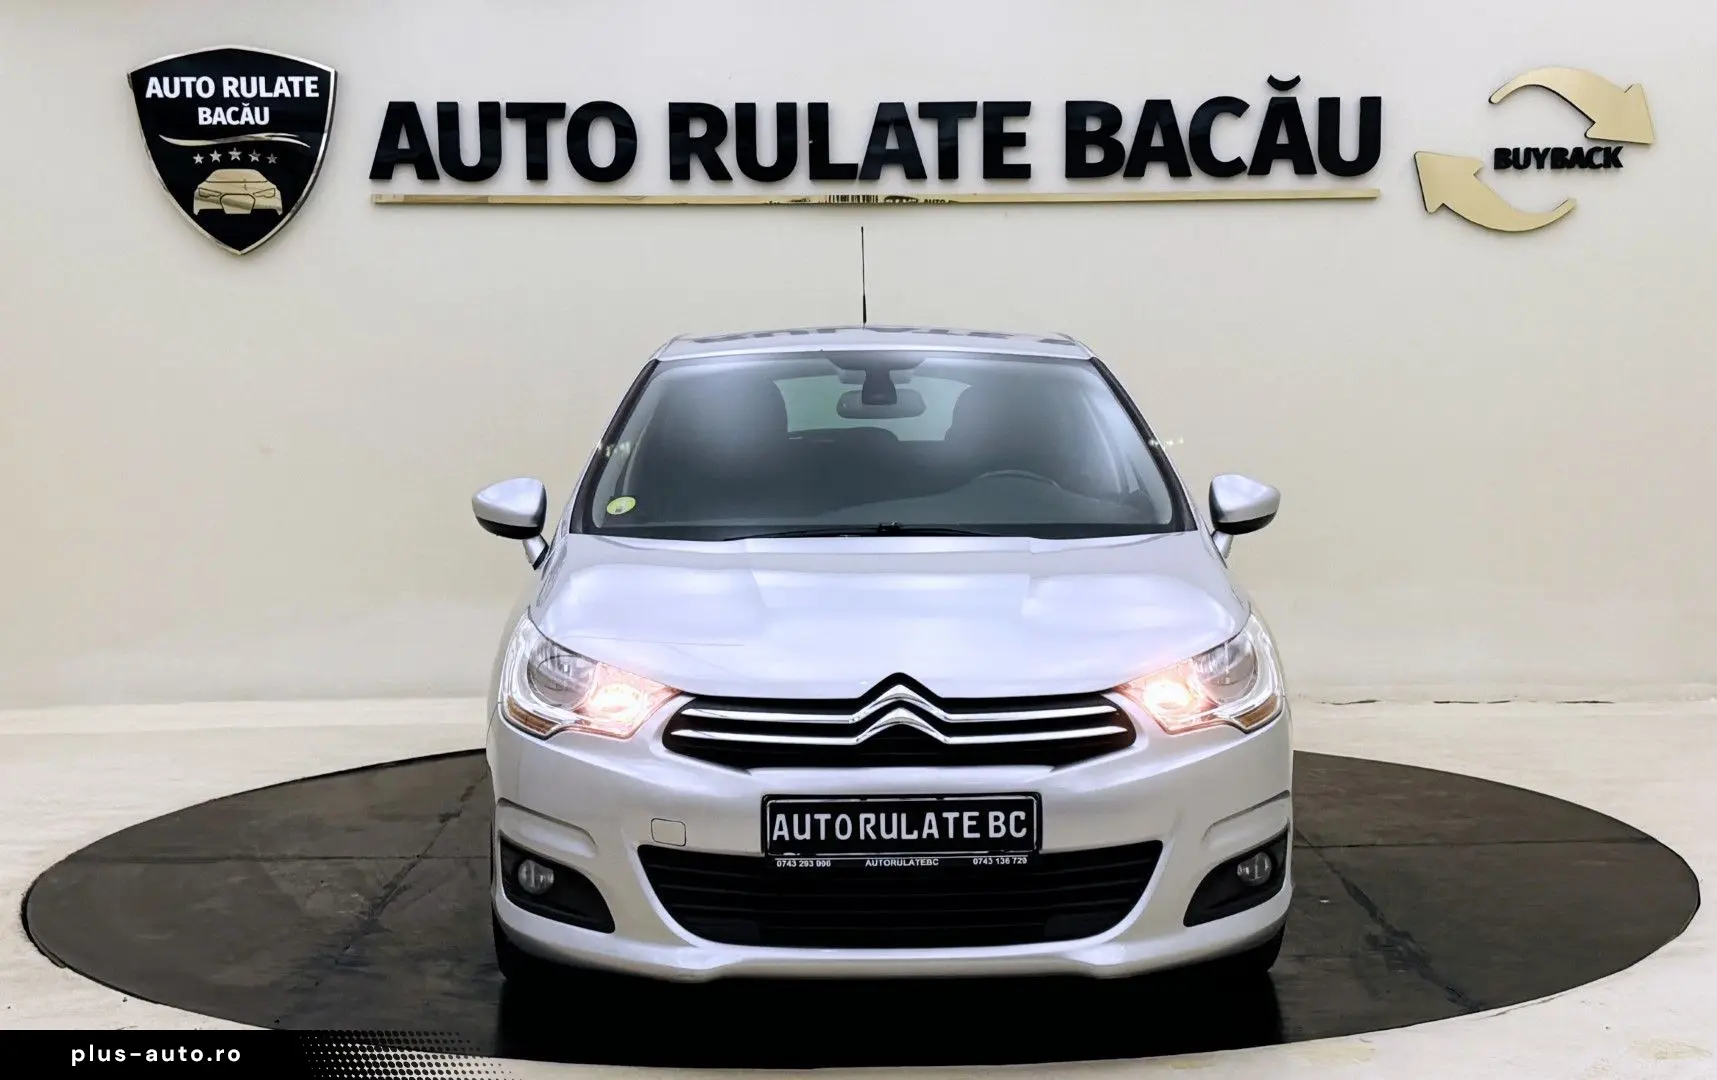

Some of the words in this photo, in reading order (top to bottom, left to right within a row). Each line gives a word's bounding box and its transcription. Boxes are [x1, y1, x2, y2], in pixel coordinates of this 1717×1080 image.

[145, 76, 216, 99] AUTO
[222, 75, 320, 98] RULATE
[198, 102, 270, 126] BACĂU
[369, 100, 638, 182] AUTO
[668, 100, 1032, 182] RULATE
[1065, 75, 1382, 179] BACĂU
[1493, 145, 1624, 170] BUYBACK
[772, 813, 853, 841] AUTO
[859, 811, 981, 840] RULATE
[988, 810, 1028, 838] BC
[776, 859, 797, 868] 0743
[864, 858, 940, 867] AUTORULATEBC
[972, 857, 993, 865] 0743
